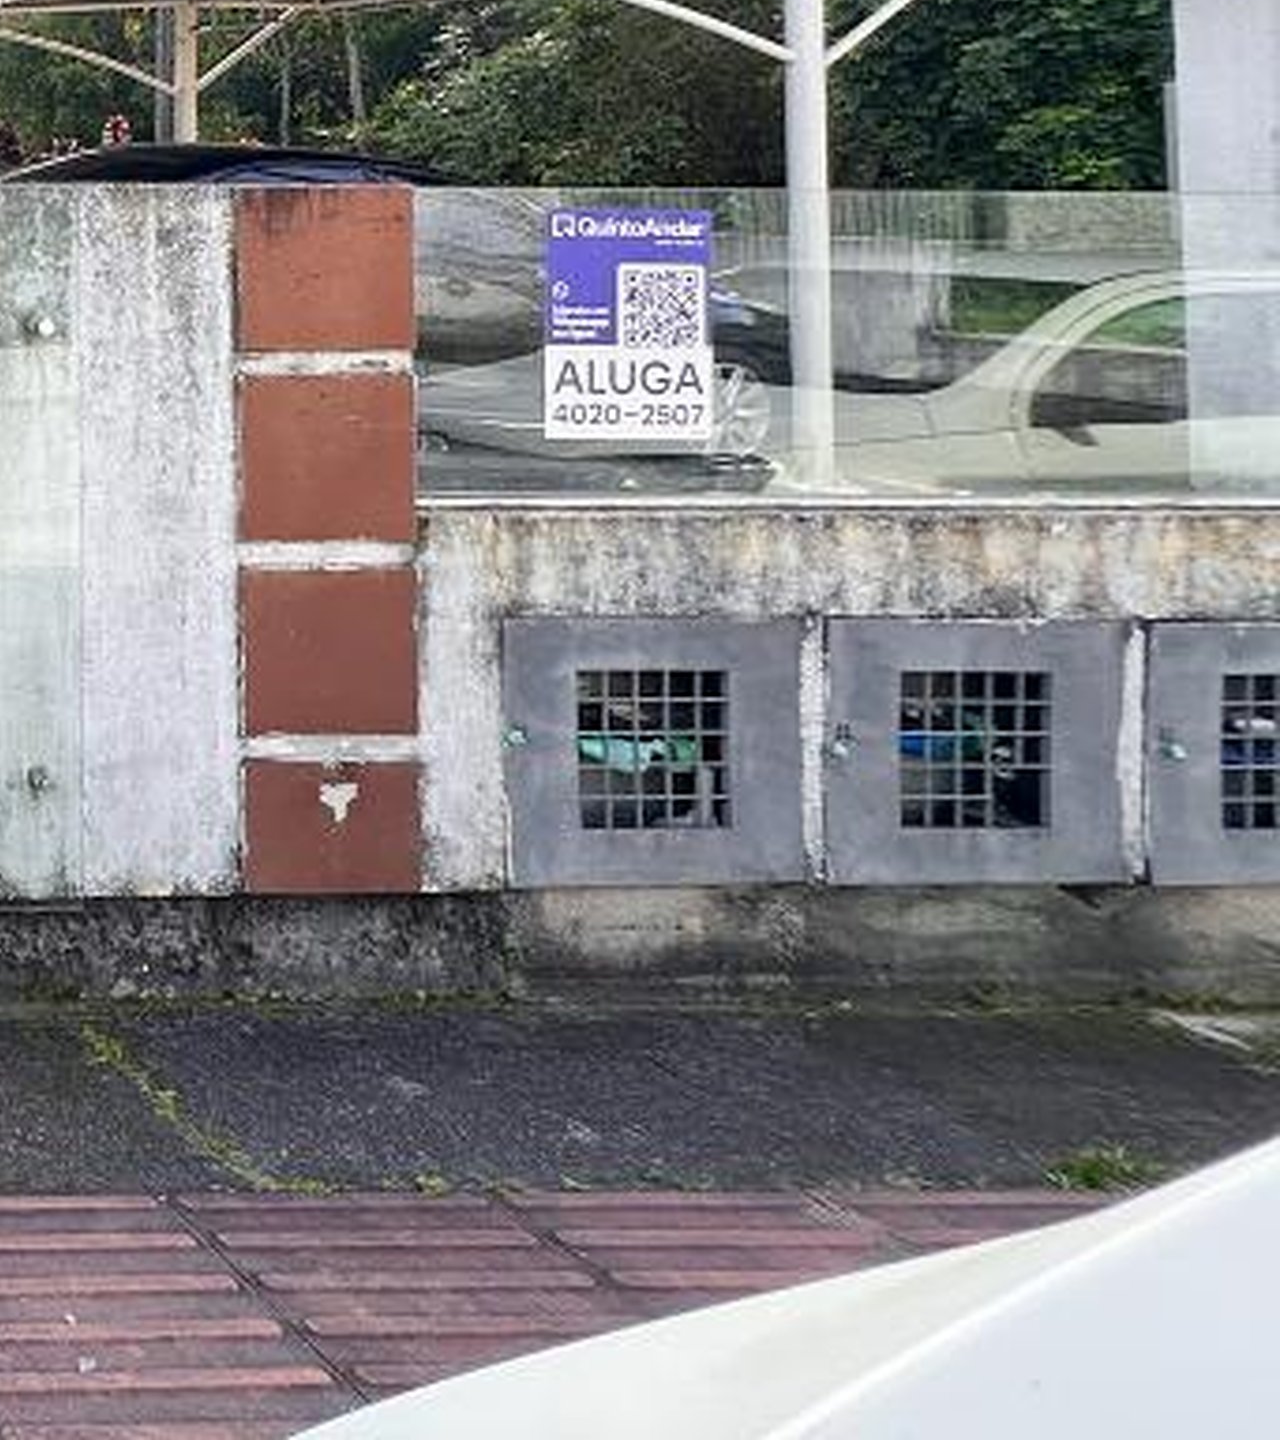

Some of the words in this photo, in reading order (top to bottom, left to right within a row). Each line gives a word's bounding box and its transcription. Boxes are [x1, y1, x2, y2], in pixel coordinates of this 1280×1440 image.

[578, 215, 704, 238] QuintoAndar
[554, 360, 704, 395] ALUGA
[552, 404, 704, 426] 4020-2507
